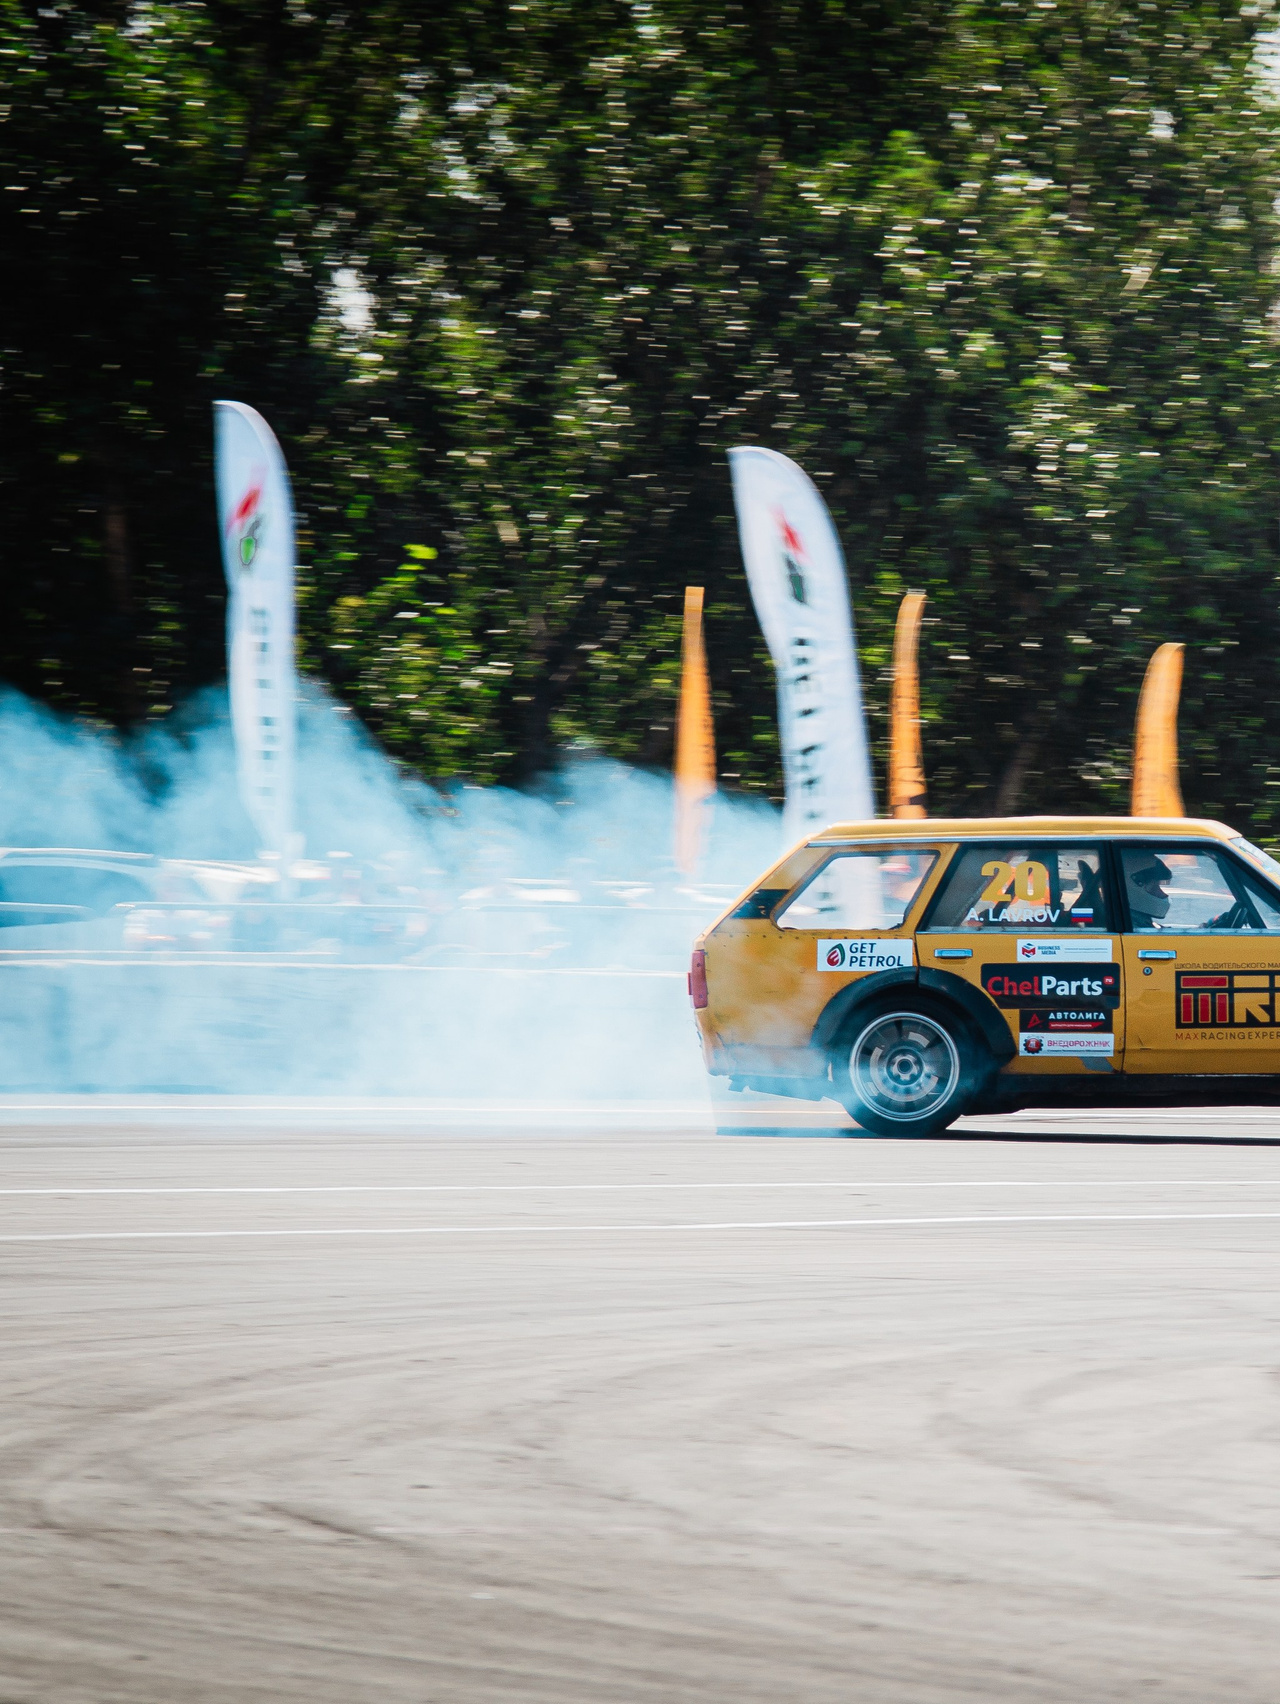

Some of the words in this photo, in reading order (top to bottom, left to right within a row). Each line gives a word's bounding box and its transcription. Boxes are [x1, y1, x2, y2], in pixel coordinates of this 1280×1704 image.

[981, 860, 1047, 902] 20
[967, 907, 984, 922] A.
[989, 908, 1060, 923] LAVROV
[849, 942, 876, 954] GET
[849, 955, 904, 967] PETROL
[1174, 962, 1201, 970] ШКОЛА
[986, 975, 1103, 996] ChelParts
[1048, 1012, 1106, 1020] АВТОЛИГА
[1047, 1040, 1110, 1048] ВНЕДОРОЖНИК
